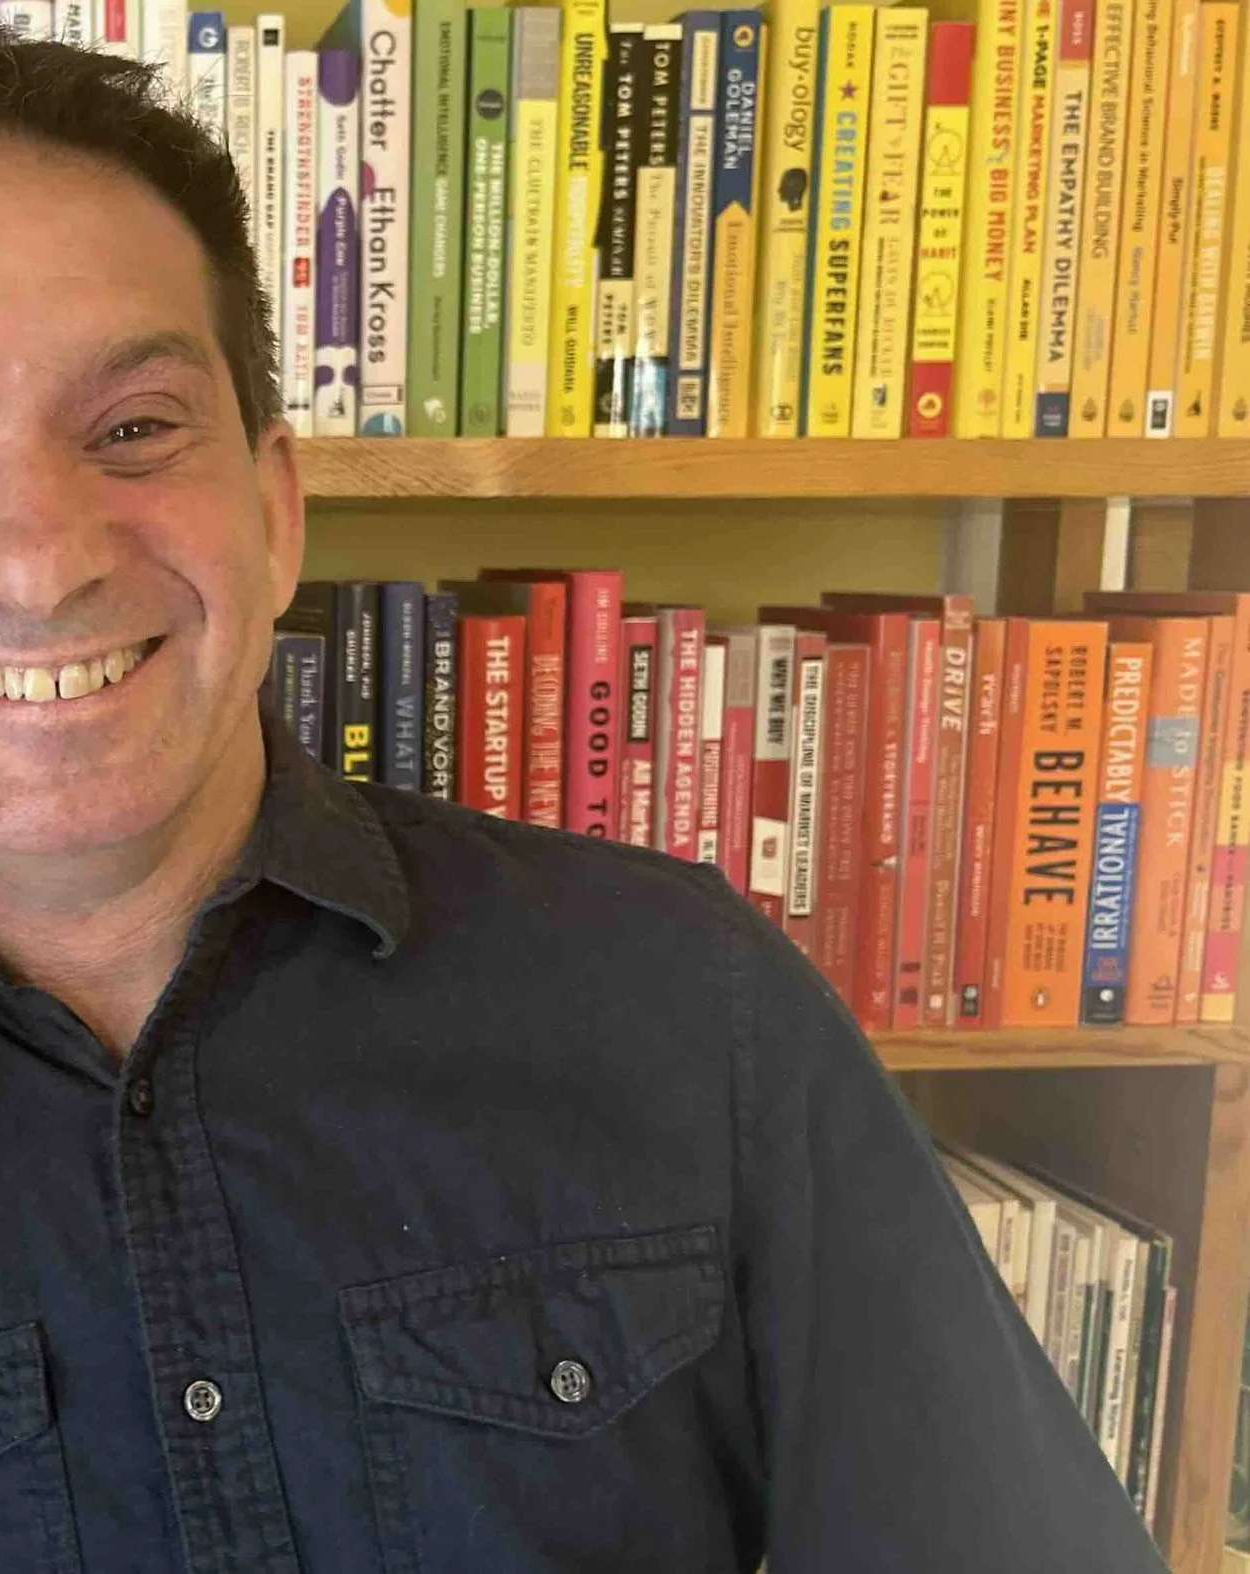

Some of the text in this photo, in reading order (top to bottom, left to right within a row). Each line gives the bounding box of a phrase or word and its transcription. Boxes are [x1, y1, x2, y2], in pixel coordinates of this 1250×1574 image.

[568, 32, 594, 171] UNREASONABLE
[612, 73, 635, 201] TOM PETERS
[648, 42, 671, 166] TOM PETERS
[723, 68, 742, 170] GOLEMAN
[740, 82, 755, 157] DANIEL
[884, 63, 910, 128] GIFT
[1090, 4, 1123, 260] EFFECTIVE BRAND BUILDING
[266, 156, 277, 200] BRAND
[295, 77, 312, 247] STRENGTHSFINDER
[490, 142, 504, 174] THE
[695, 125, 709, 158] THE
[982, 45, 1015, 283] BUSINESS BIG MONEY
[1022, 24, 1050, 255] 1-PAGE MARKETING PLAN
[333, 196, 349, 239] Purple
[367, 30, 397, 364] Chatter Ethan Kross
[1048, 91, 1082, 363] THE EMPATHY DILEMMA
[1132, 167, 1149, 232] Marketing
[1167, 178, 1183, 245] Simply Put
[334, 242, 347, 267] Cow
[723, 221, 743, 317] Emotional
[822, 110, 857, 377] CREATING SUPERFANS
[469, 259, 485, 335] BUSINESS
[687, 282, 702, 361] DILEMMA
[300, 655, 318, 708] Thank
[433, 640, 451, 731] BRAND
[483, 636, 510, 801] THE STARTUP
[530, 653, 560, 737] DECODING
[631, 651, 649, 739] SETH GODIN
[767, 656, 788, 744] WHY WE BUY
[804, 664, 820, 692] THE
[941, 647, 965, 731] DRIVE
[1039, 645, 1064, 733] SAPOLSKY
[1066, 645, 1088, 708] ROBERT
[1175, 637, 1202, 719] MADE
[394, 695, 415, 772] WHAT
[529, 741, 560, 774] THE
[588, 681, 609, 778] GOOD
[673, 629, 698, 847] THE HIDDEN AGENDA
[1103, 656, 1144, 803] PREDICTABLY
[632, 761, 651, 785] All
[1166, 765, 1190, 849] STICK
[1231, 777, 1243, 811] FOOD
[1022, 749, 1085, 907] BEHAVE
[1091, 808, 1131, 951] IRRATIONAL
